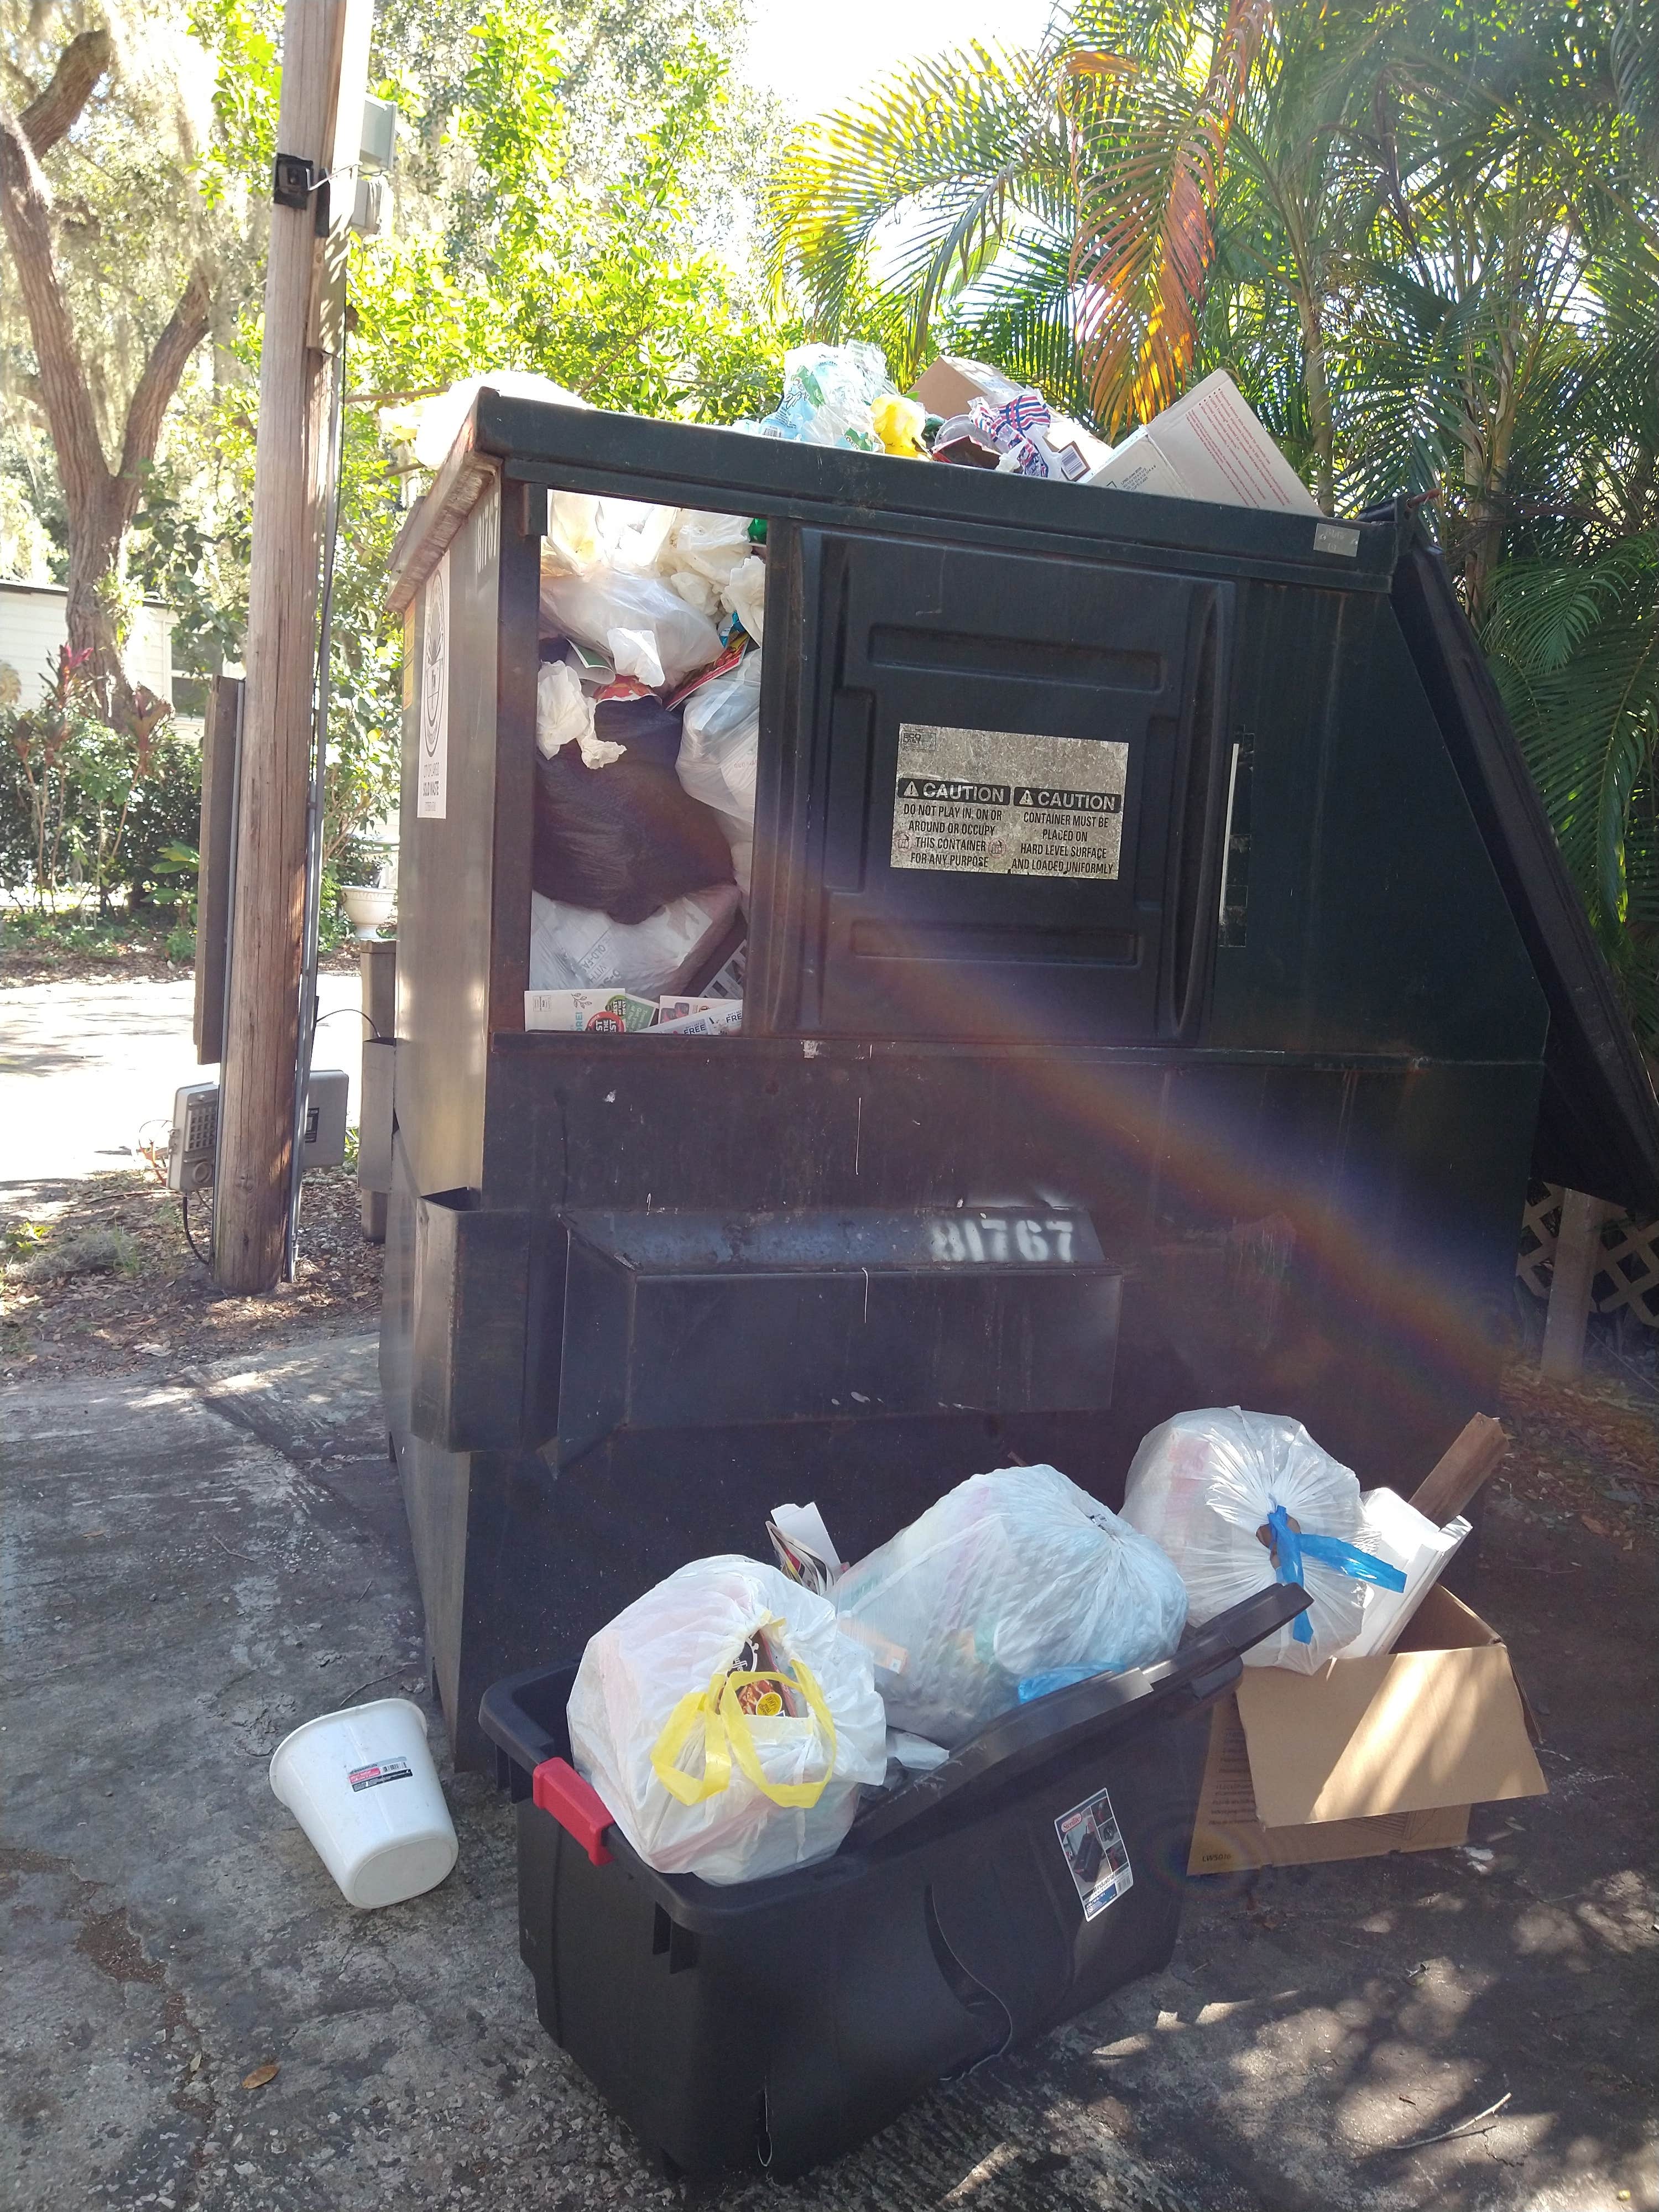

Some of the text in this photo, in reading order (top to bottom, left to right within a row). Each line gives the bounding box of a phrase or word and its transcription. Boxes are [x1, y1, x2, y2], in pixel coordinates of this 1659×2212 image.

[923, 782, 1004, 802] CAUTION
[1037, 791, 1115, 811] CAUTION
[904, 804, 1002, 821] DO NOT PLAY IN, ON OR
[1024, 812, 1109, 828] CONTAINER MUST BE
[909, 821, 995, 836] AROUND OR OCCUPY
[1042, 829, 1088, 842] PLACED ON
[915, 837, 986, 852] THIS CONTAINER
[1021, 843, 1107, 859] HARD LEVEL SURFACE
[911, 853, 989, 867] FOR ANY PURPOSE
[1011, 858, 1113, 874] AND LOADED UNIFORMLY
[726, 1013, 742, 1023] FRE
[684, 1024, 706, 1034] FREE
